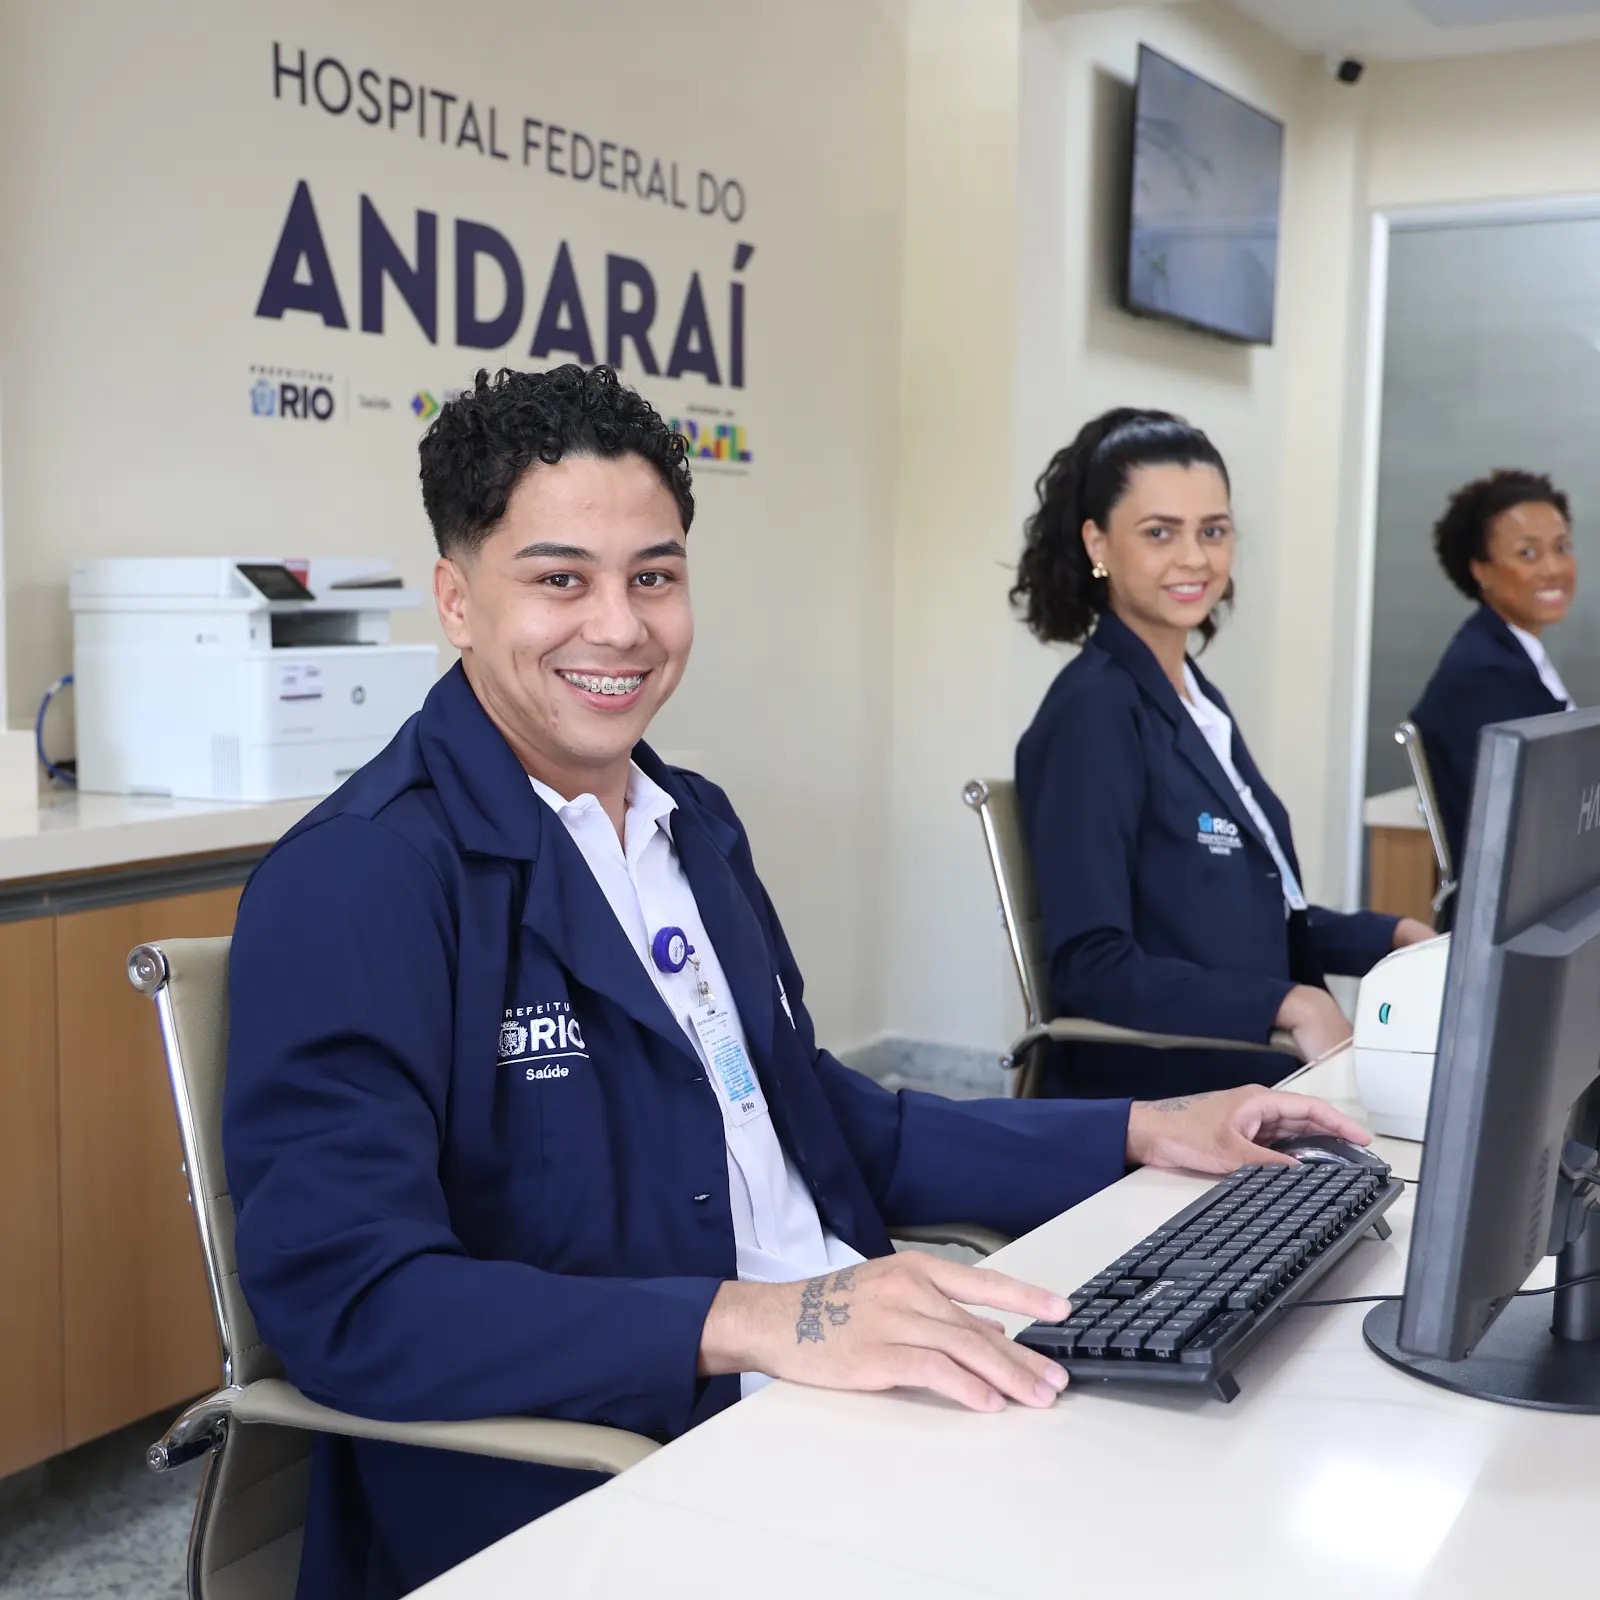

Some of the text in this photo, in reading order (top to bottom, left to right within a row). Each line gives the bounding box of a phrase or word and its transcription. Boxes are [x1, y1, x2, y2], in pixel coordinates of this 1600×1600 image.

[272, 41, 744, 223] HOSPITAL FEDERAL DO
[255, 179, 755, 389] ANDARAÍ
[280, 383, 334, 422] RIO
[529, 1014, 586, 1052] RIO
[526, 1063, 569, 1080] Saúde
